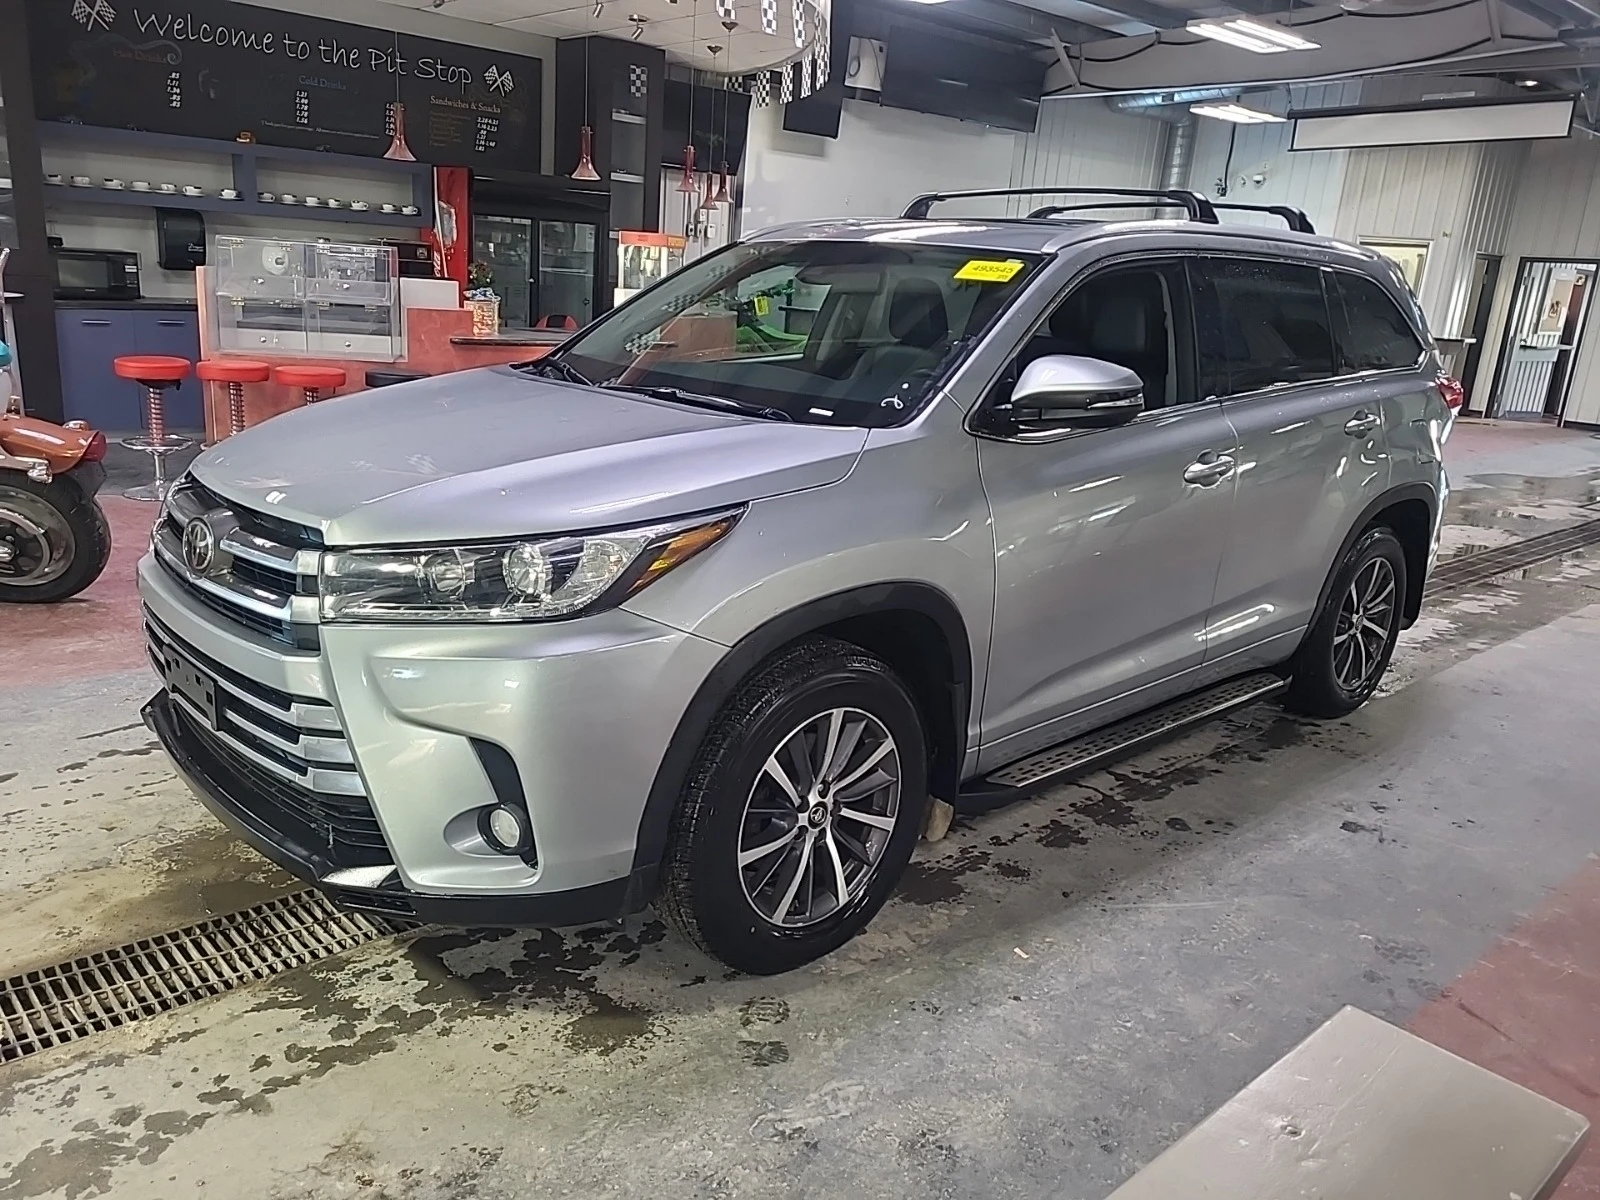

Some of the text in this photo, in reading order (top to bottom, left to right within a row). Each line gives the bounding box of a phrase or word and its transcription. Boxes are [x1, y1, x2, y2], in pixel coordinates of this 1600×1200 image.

[133, 8, 472, 95] Welcome to the Pit Stop
[299, 75, 318, 87] Cold
[430, 95, 501, 114] Sandwiches & Snacks
